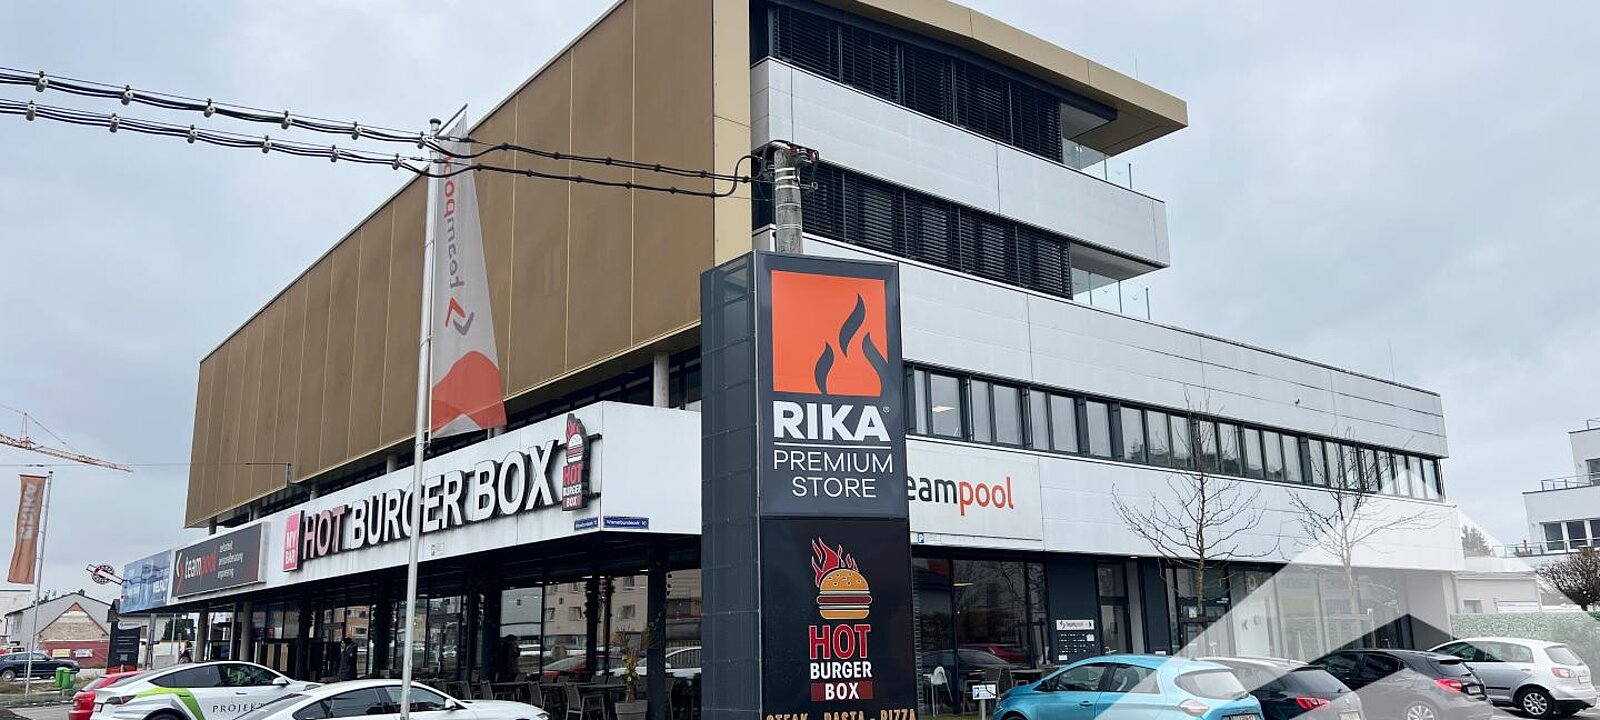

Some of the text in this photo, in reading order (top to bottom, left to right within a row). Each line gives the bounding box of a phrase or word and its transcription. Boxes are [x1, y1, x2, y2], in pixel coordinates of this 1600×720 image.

[773, 401, 891, 441] RIKA
[773, 449, 893, 473] PREMIUM
[563, 463, 582, 485] HOT
[562, 484, 582, 497] BURGER
[792, 476, 877, 498] STORE
[907, 476, 1014, 516] eampool
[303, 505, 346, 560] HOT
[472, 440, 555, 521] BOX
[566, 496, 578, 507] BOX
[286, 530, 297, 549] MY
[285, 549, 296, 566] BAR
[809, 624, 871, 660] HOT
[810, 661, 872, 680] BURGER
[825, 682, 860, 701] BOX
